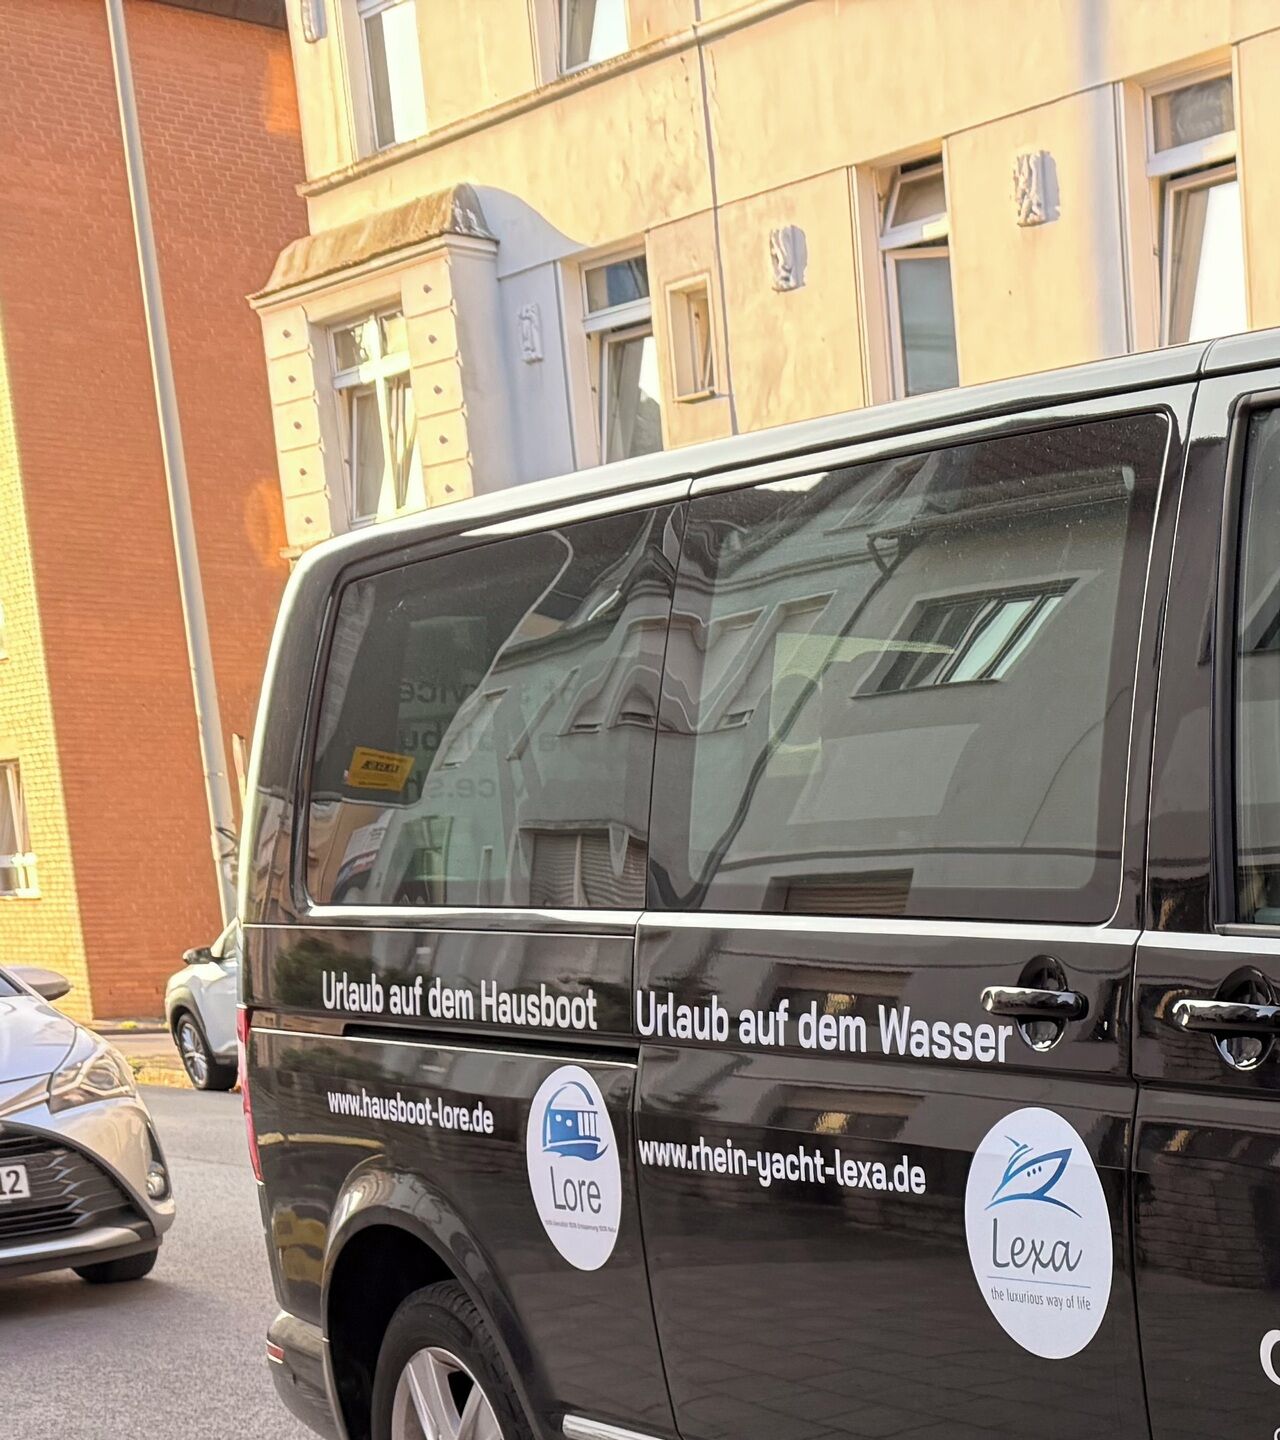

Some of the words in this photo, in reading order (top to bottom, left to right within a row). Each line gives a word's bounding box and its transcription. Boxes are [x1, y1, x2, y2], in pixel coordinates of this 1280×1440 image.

[322, 970, 384, 1014] Urlaub
[389, 975, 423, 1016] auf
[428, 977, 474, 1021] dem
[480, 979, 598, 1031] Hausboot
[636, 989, 729, 1042] Urlaub
[738, 998, 790, 1046] auf
[798, 1001, 867, 1053] dem
[878, 1004, 1013, 1063] Wasser
[327, 1088, 495, 1134] www.hausboot-lore.de
[549, 1165, 602, 1215] Lore
[638, 1136, 926, 1195] www.rhein-yacht-lexa.de
[992, 1217, 1083, 1275] Lexa
[991, 1286, 1005, 1301] the
[1006, 1288, 1044, 1305] luxurious
[1046, 1295, 1064, 1311] way
[1066, 1295, 1075, 1309] of
[1076, 1296, 1091, 1311] life
